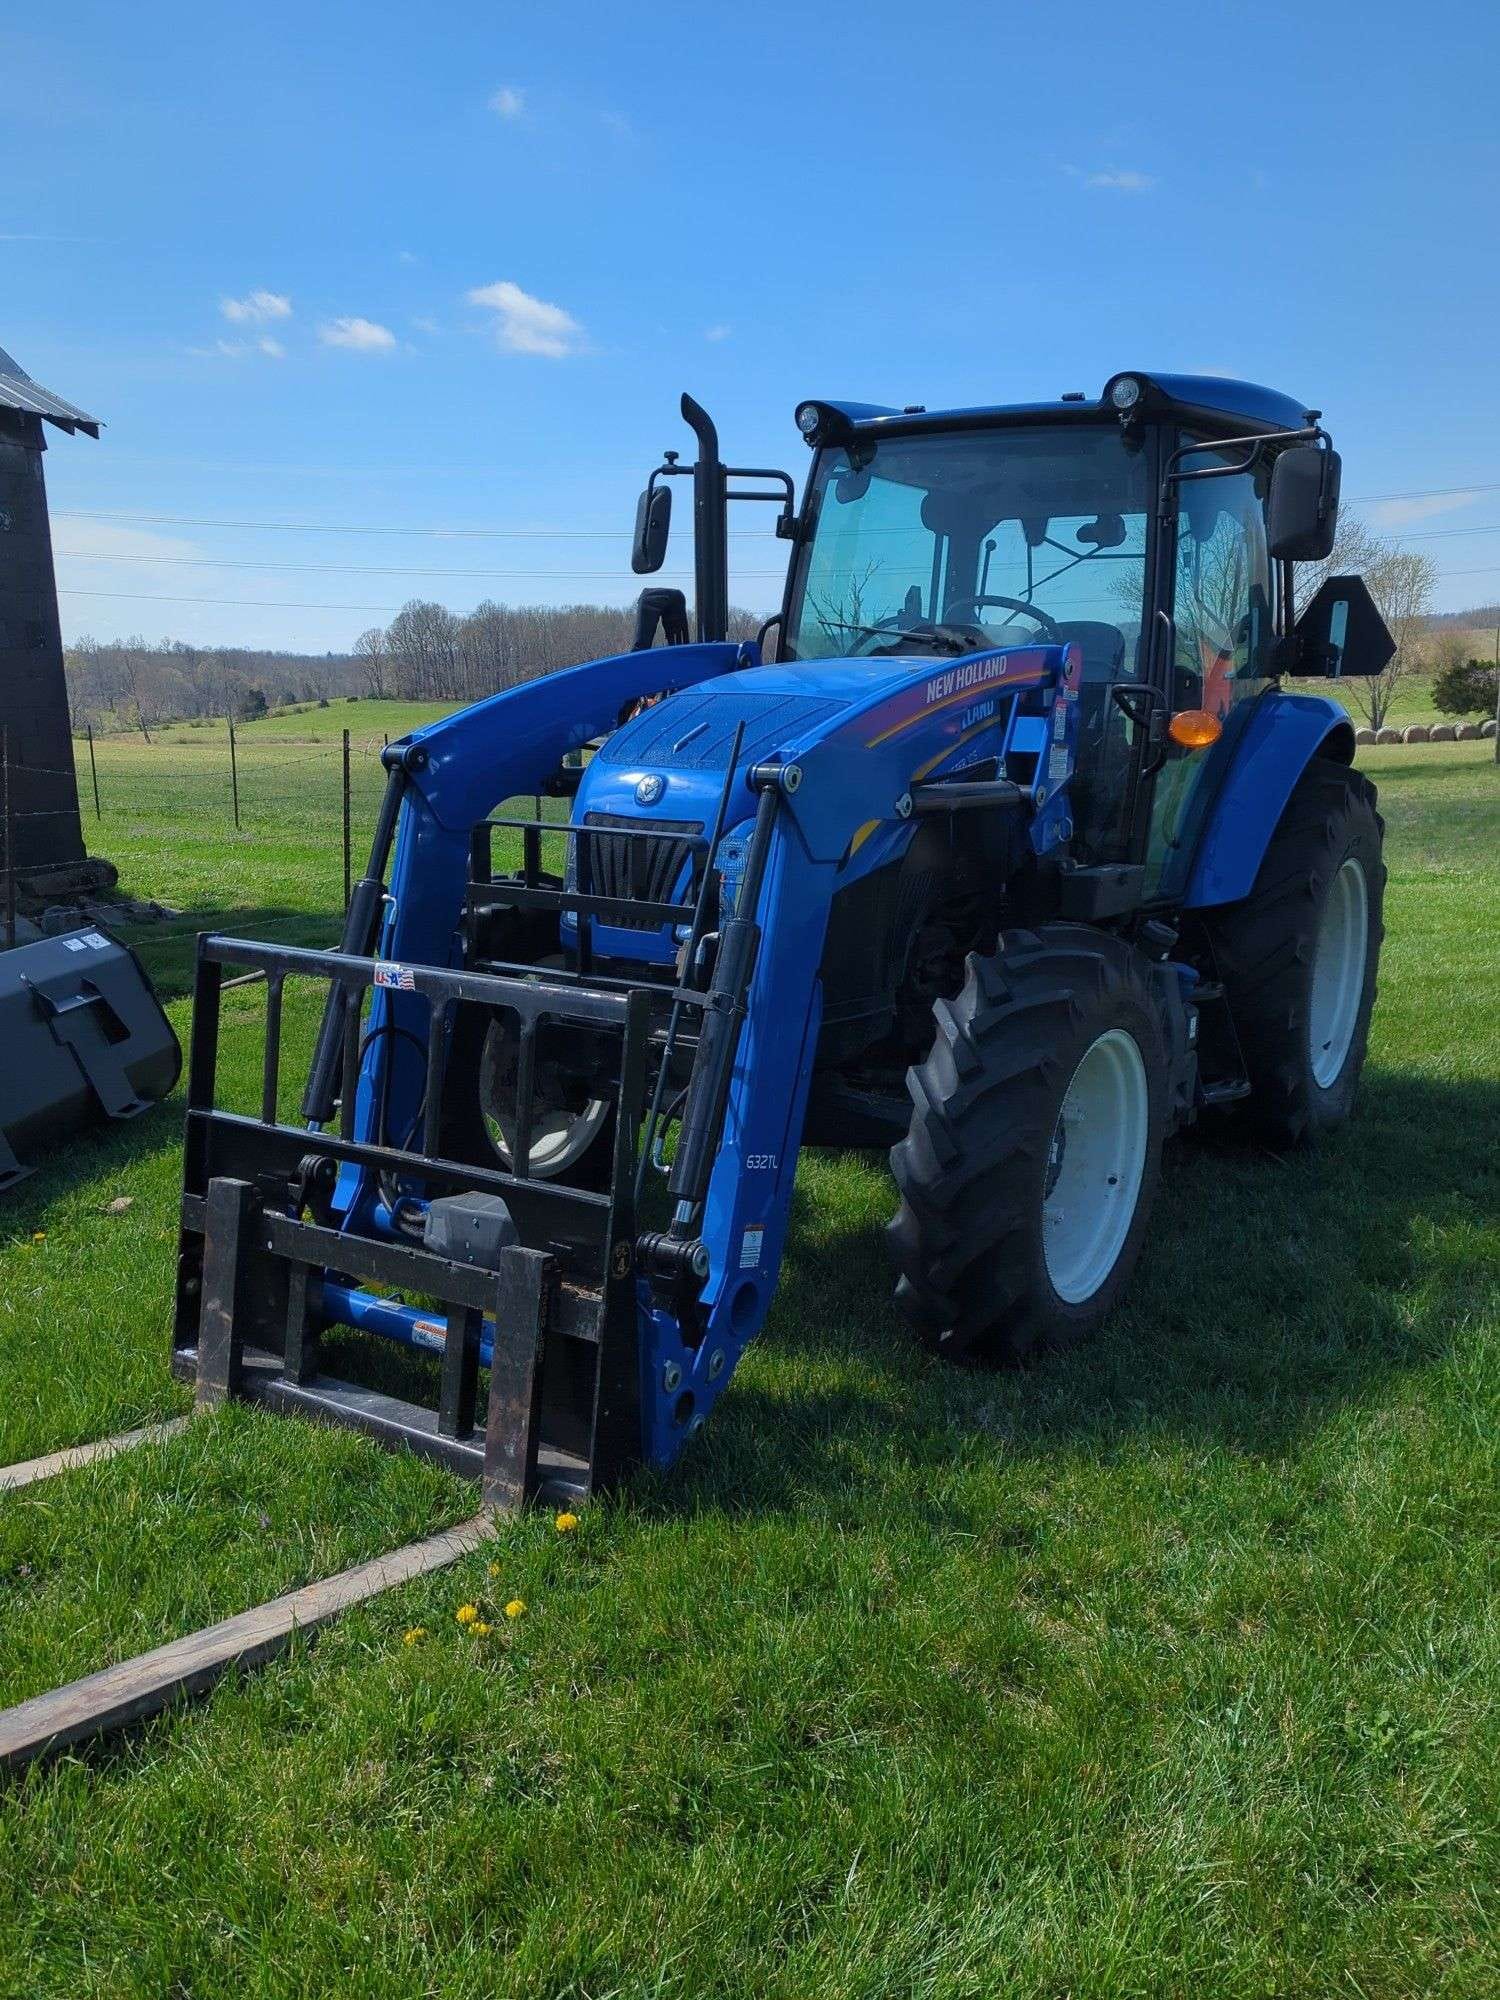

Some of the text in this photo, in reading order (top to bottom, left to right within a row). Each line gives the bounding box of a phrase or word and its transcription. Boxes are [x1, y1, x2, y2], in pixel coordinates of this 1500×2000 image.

[926, 655, 1007, 703] NEW HOLLAND
[376, 970, 399, 986] USA
[746, 1154, 778, 1169] 632TL
